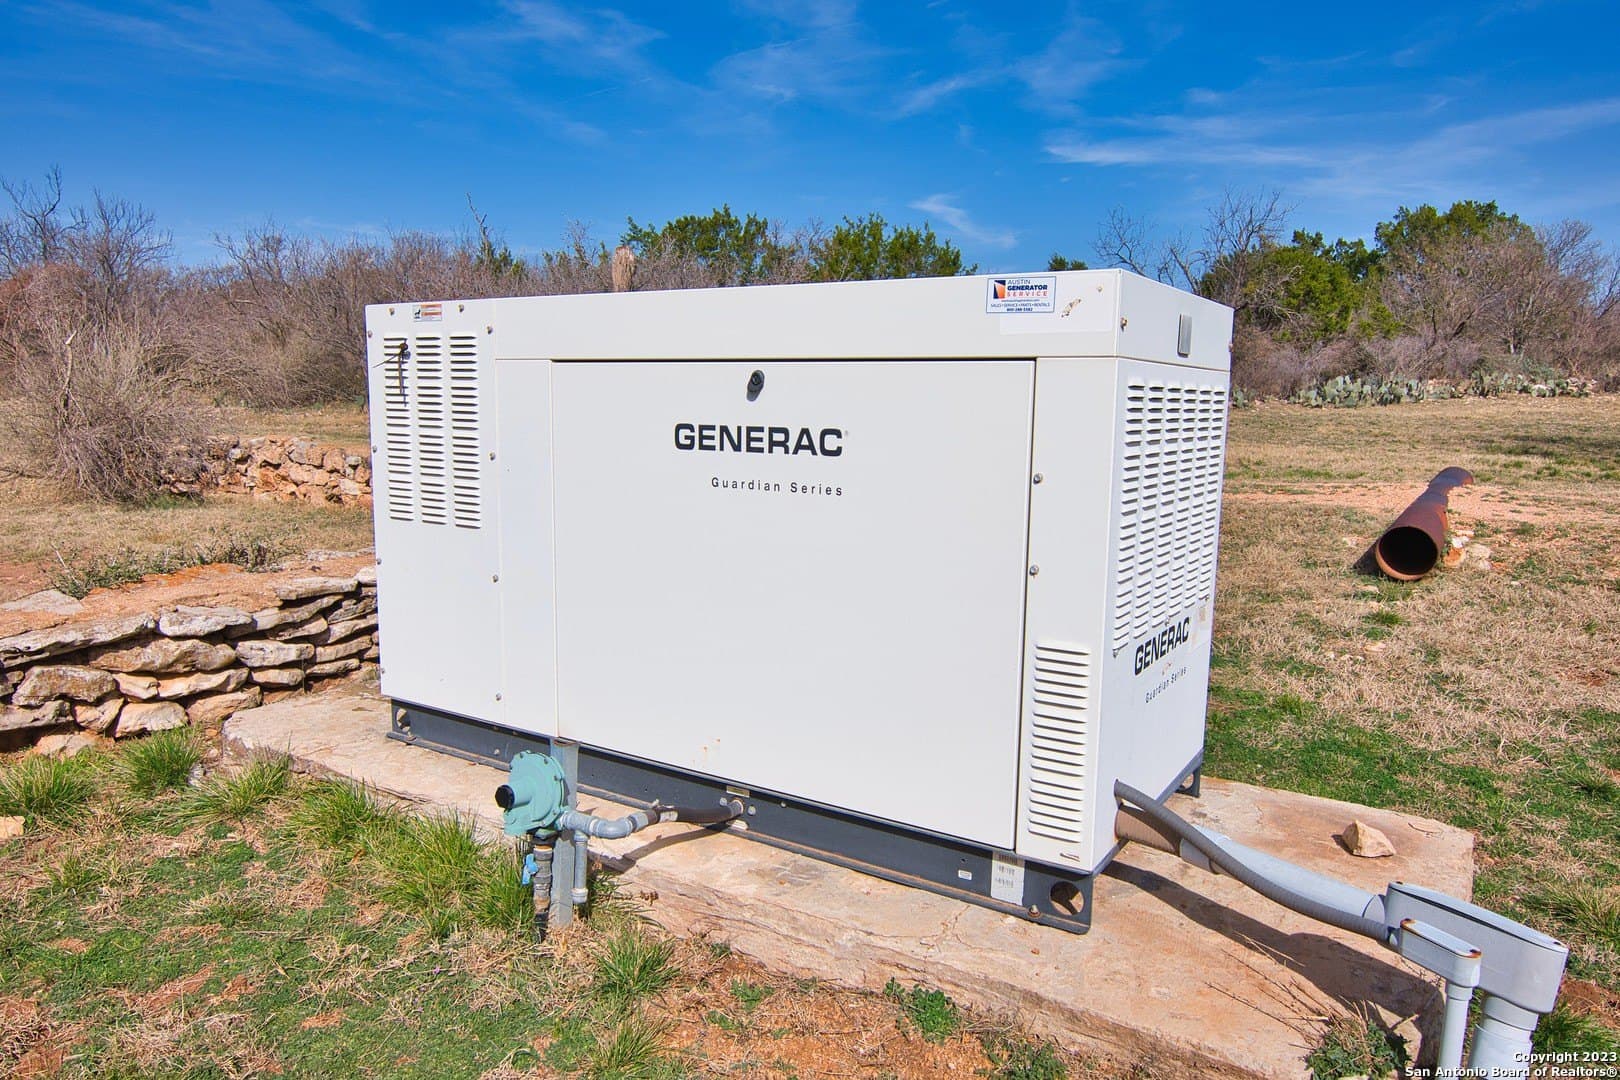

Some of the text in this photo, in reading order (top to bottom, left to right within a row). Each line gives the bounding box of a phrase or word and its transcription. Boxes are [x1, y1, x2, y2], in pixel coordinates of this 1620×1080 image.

[674, 423, 843, 457] GENERAC
[711, 477, 842, 496] Guardian Series
[1134, 616, 1190, 676] GENERAC
[1145, 679, 1169, 703] Guardian
